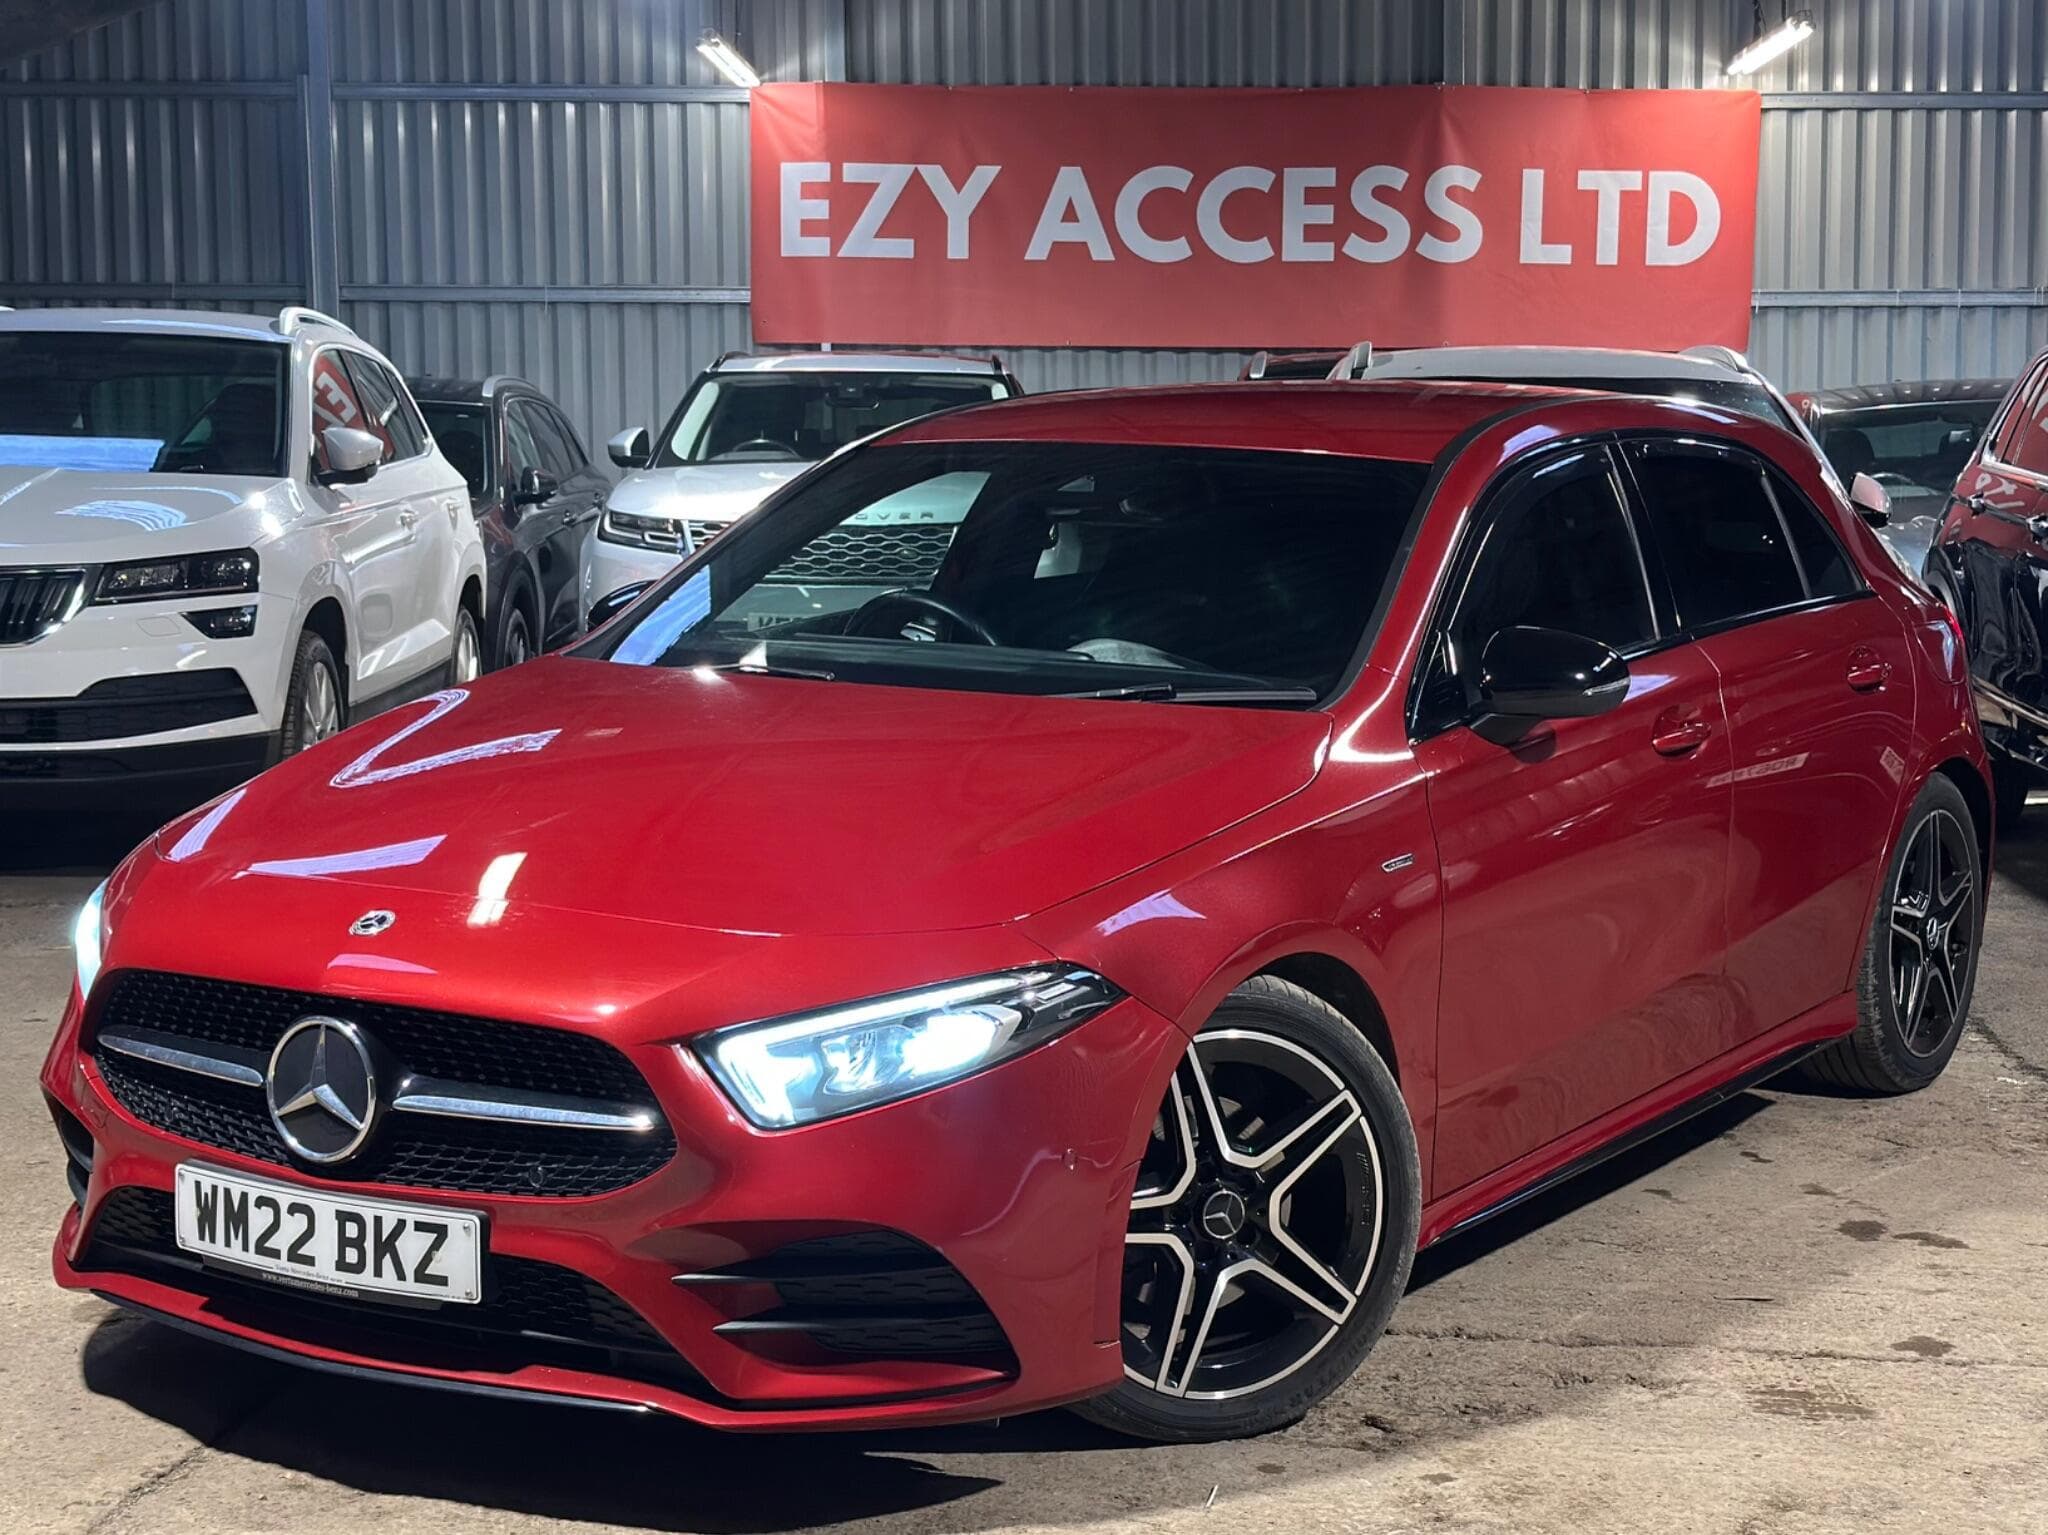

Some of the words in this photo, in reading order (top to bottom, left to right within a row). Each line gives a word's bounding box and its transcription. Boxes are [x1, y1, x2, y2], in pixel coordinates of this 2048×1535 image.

[780, 162, 1002, 260] EZY
[1023, 165, 1484, 263] ACCESS
[1520, 168, 1722, 266] LTD
[855, 511, 934, 520] OVER
[194, 1180, 316, 1267] WM22
[335, 1209, 449, 1287] BKZ
